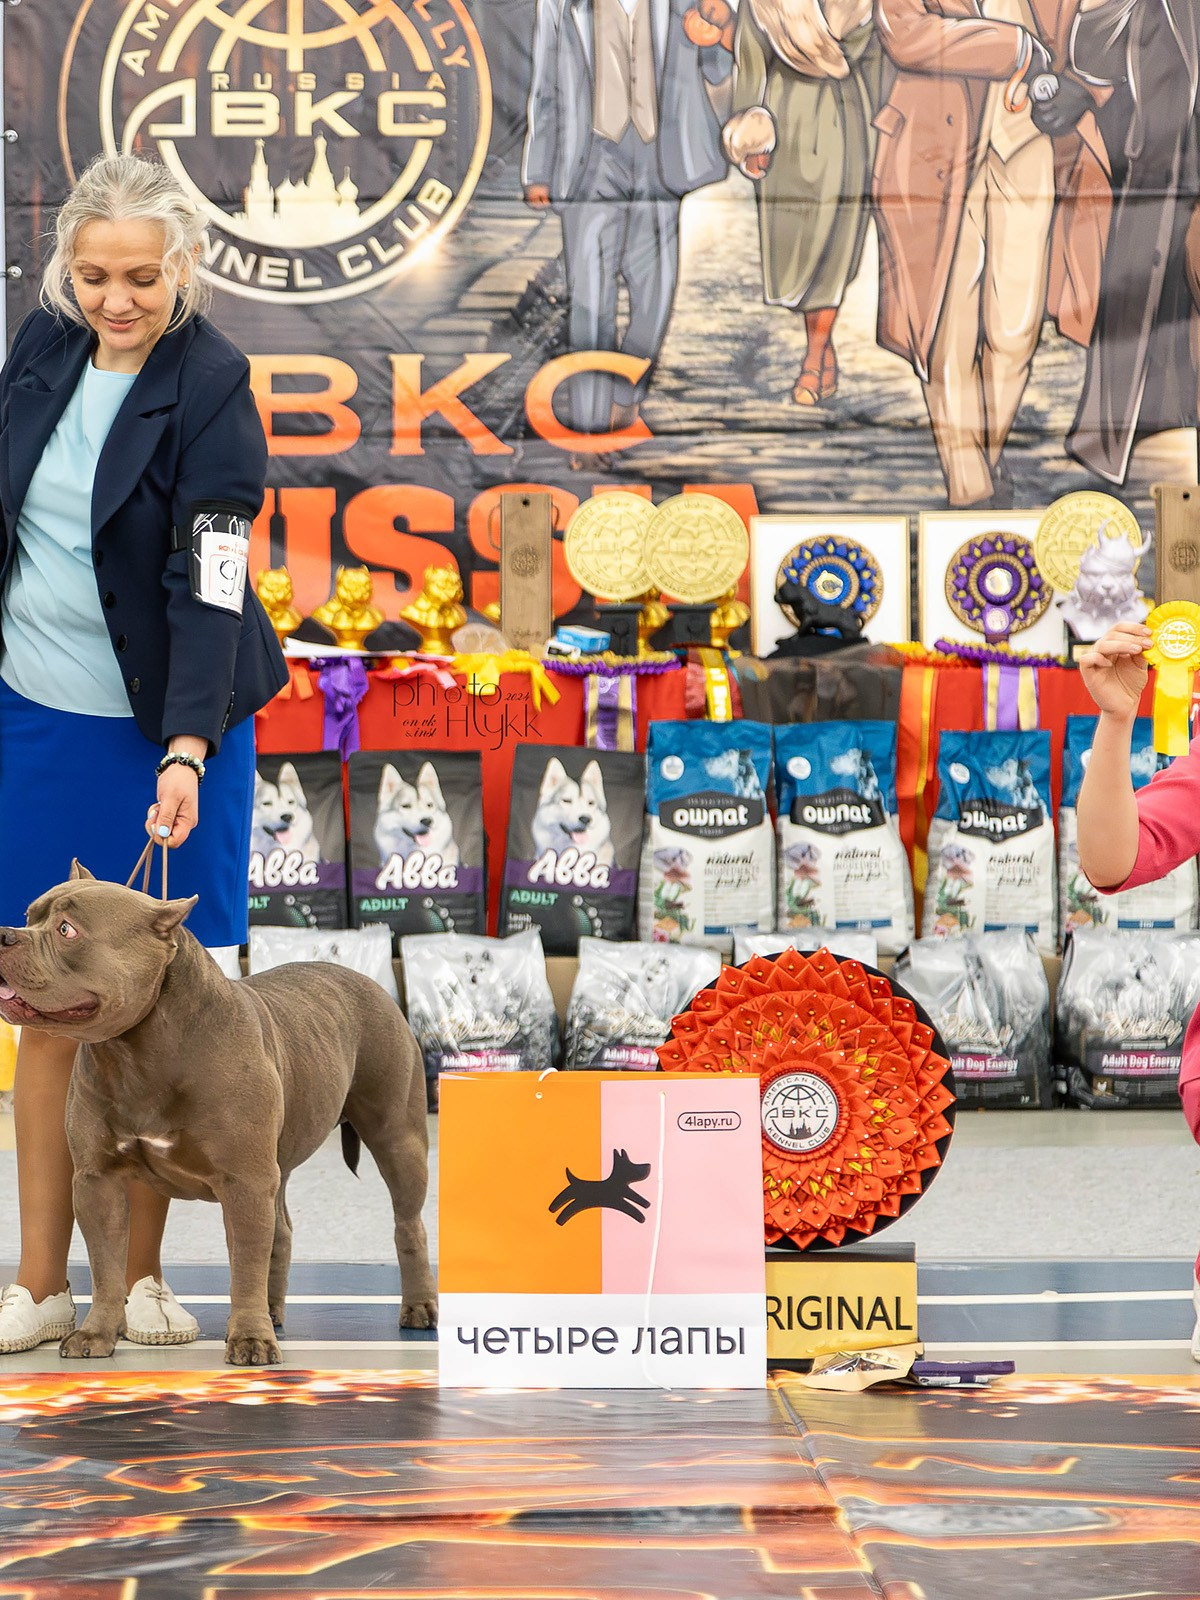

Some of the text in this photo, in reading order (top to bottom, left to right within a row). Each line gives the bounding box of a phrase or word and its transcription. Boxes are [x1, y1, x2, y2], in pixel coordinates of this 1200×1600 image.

[211, 72, 447, 91] RUSSIA
[122, 77, 447, 140] ABKC
[202, 177, 453, 288] NNEL CLUB
[673, 805, 749, 827] ownat
[802, 804, 872, 825] ownat
[360, 897, 409, 912] ADULT
[510, 889, 559, 906] ADULT
[966, 1057, 985, 1071] Dog
[986, 1057, 1018, 1071] Energy
[1102, 1054, 1182, 1070] Adult Dog Energy
[764, 1076, 834, 1107] AMERICAN BULLY
[684, 1117, 733, 1129] 4lapy.ru
[768, 1126, 831, 1149] KENNEL CLUB
[457, 1326, 746, 1355] четыре лапы
